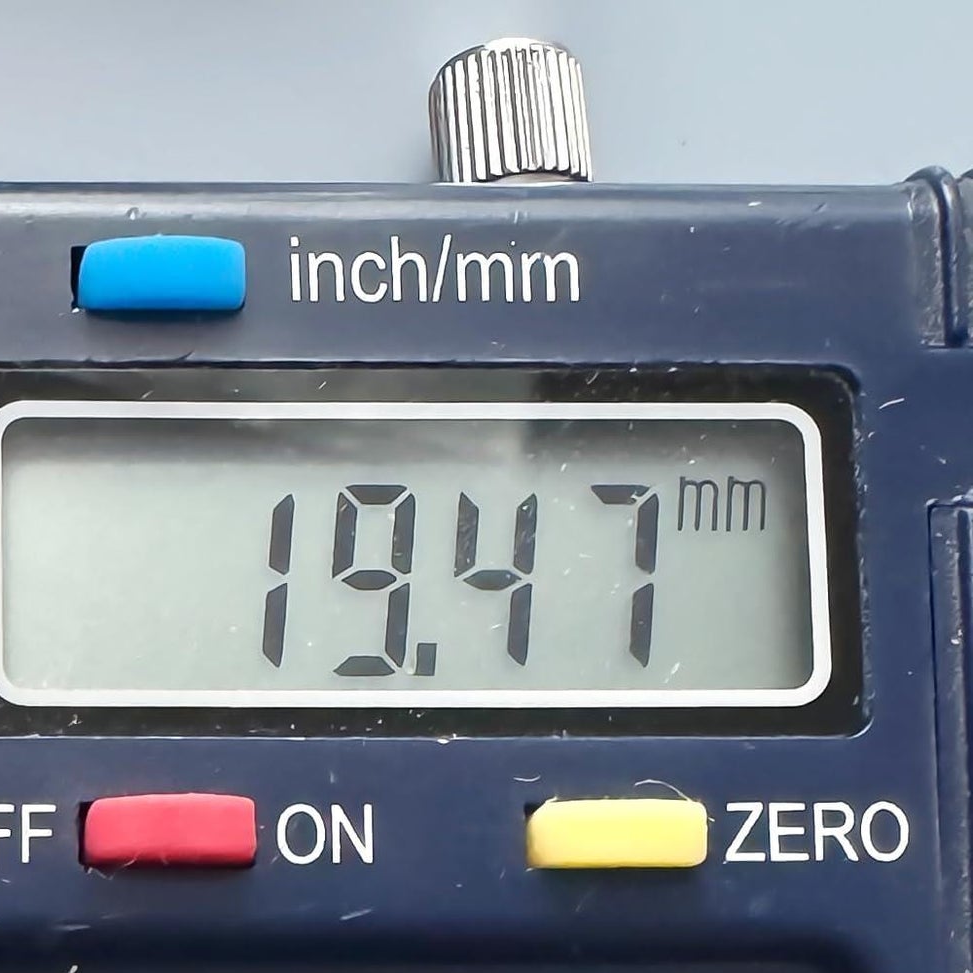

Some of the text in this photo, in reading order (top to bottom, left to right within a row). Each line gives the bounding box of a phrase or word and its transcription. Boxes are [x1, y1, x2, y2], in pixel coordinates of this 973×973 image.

[289, 235, 581, 304] inch/mm
[262, 475, 768, 677] 19.47 mm
[276, 803, 375, 865] ON
[724, 801, 910, 865] ZERO
